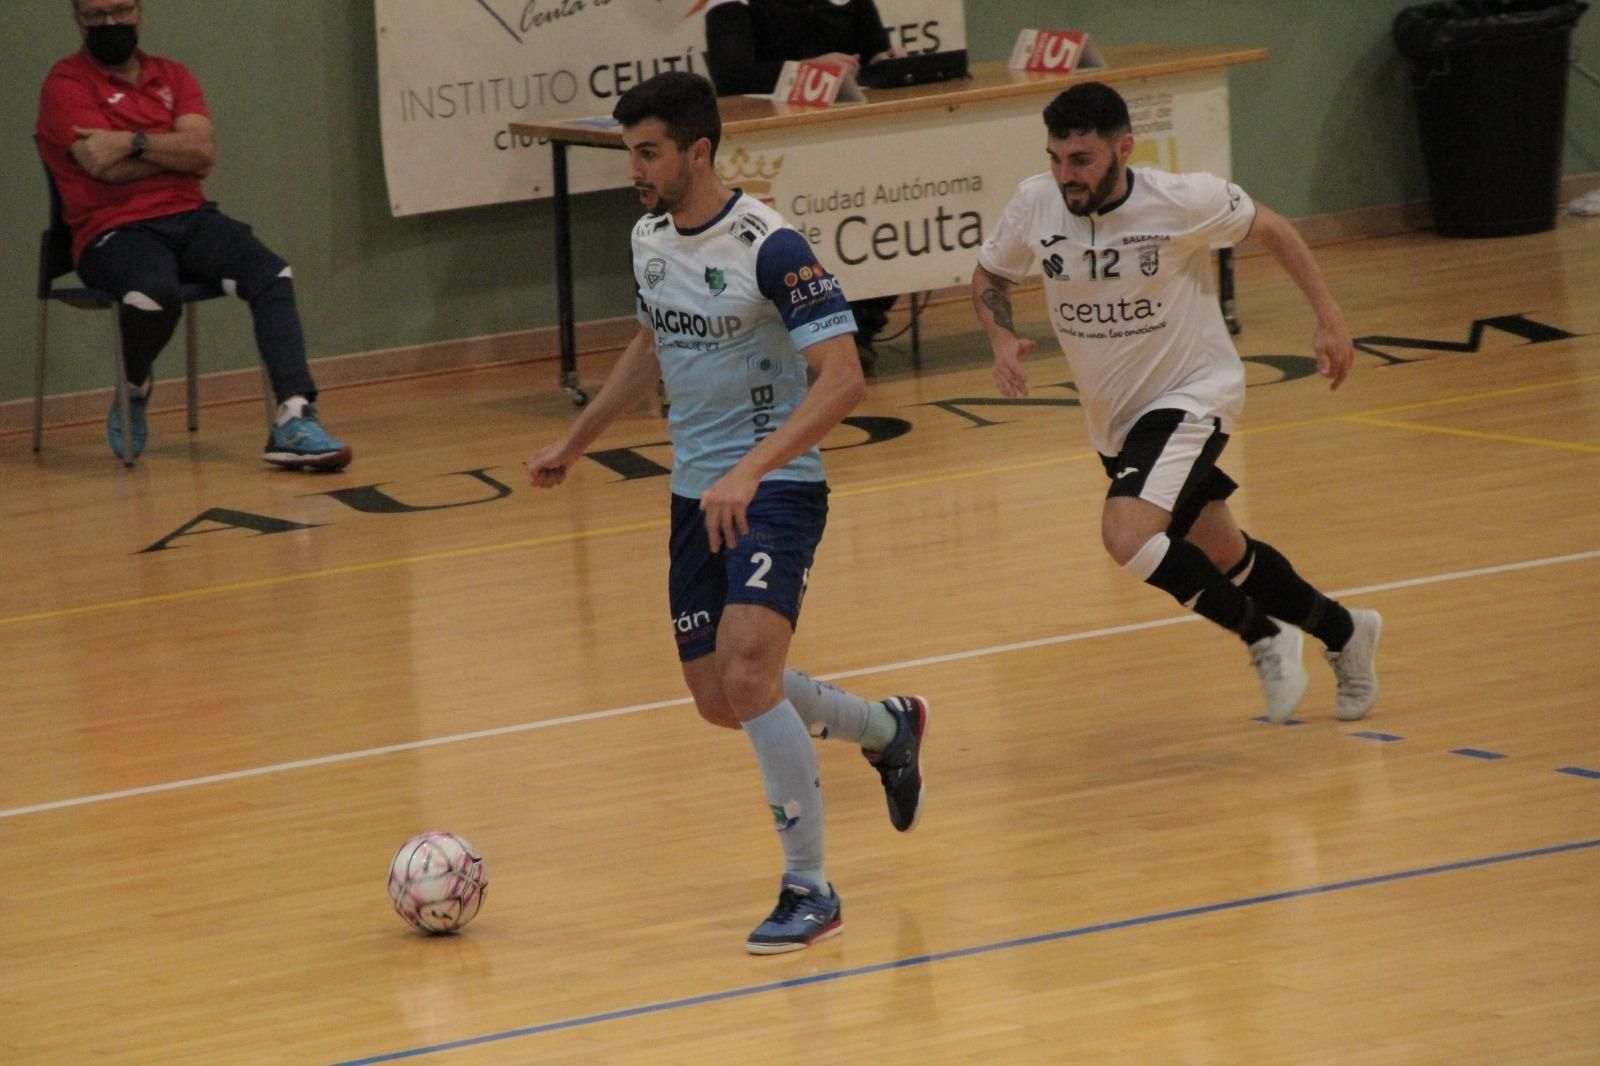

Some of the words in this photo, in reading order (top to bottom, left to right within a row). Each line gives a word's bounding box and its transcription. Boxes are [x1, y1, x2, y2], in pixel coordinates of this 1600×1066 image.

[400, 69, 578, 122] INSTITUTO
[589, 47, 696, 98] CEUTÍ
[792, 186, 865, 216] Ciudad
[873, 175, 984, 204] Autónoma
[835, 205, 984, 266] Ceuta
[1083, 248, 1121, 281] 12
[790, 288, 807, 304] EL
[808, 277, 841, 296] EJIDO
[809, 312, 848, 333] Durán
[1059, 298, 1154, 324] ceuta
[745, 551, 772, 590] 2
